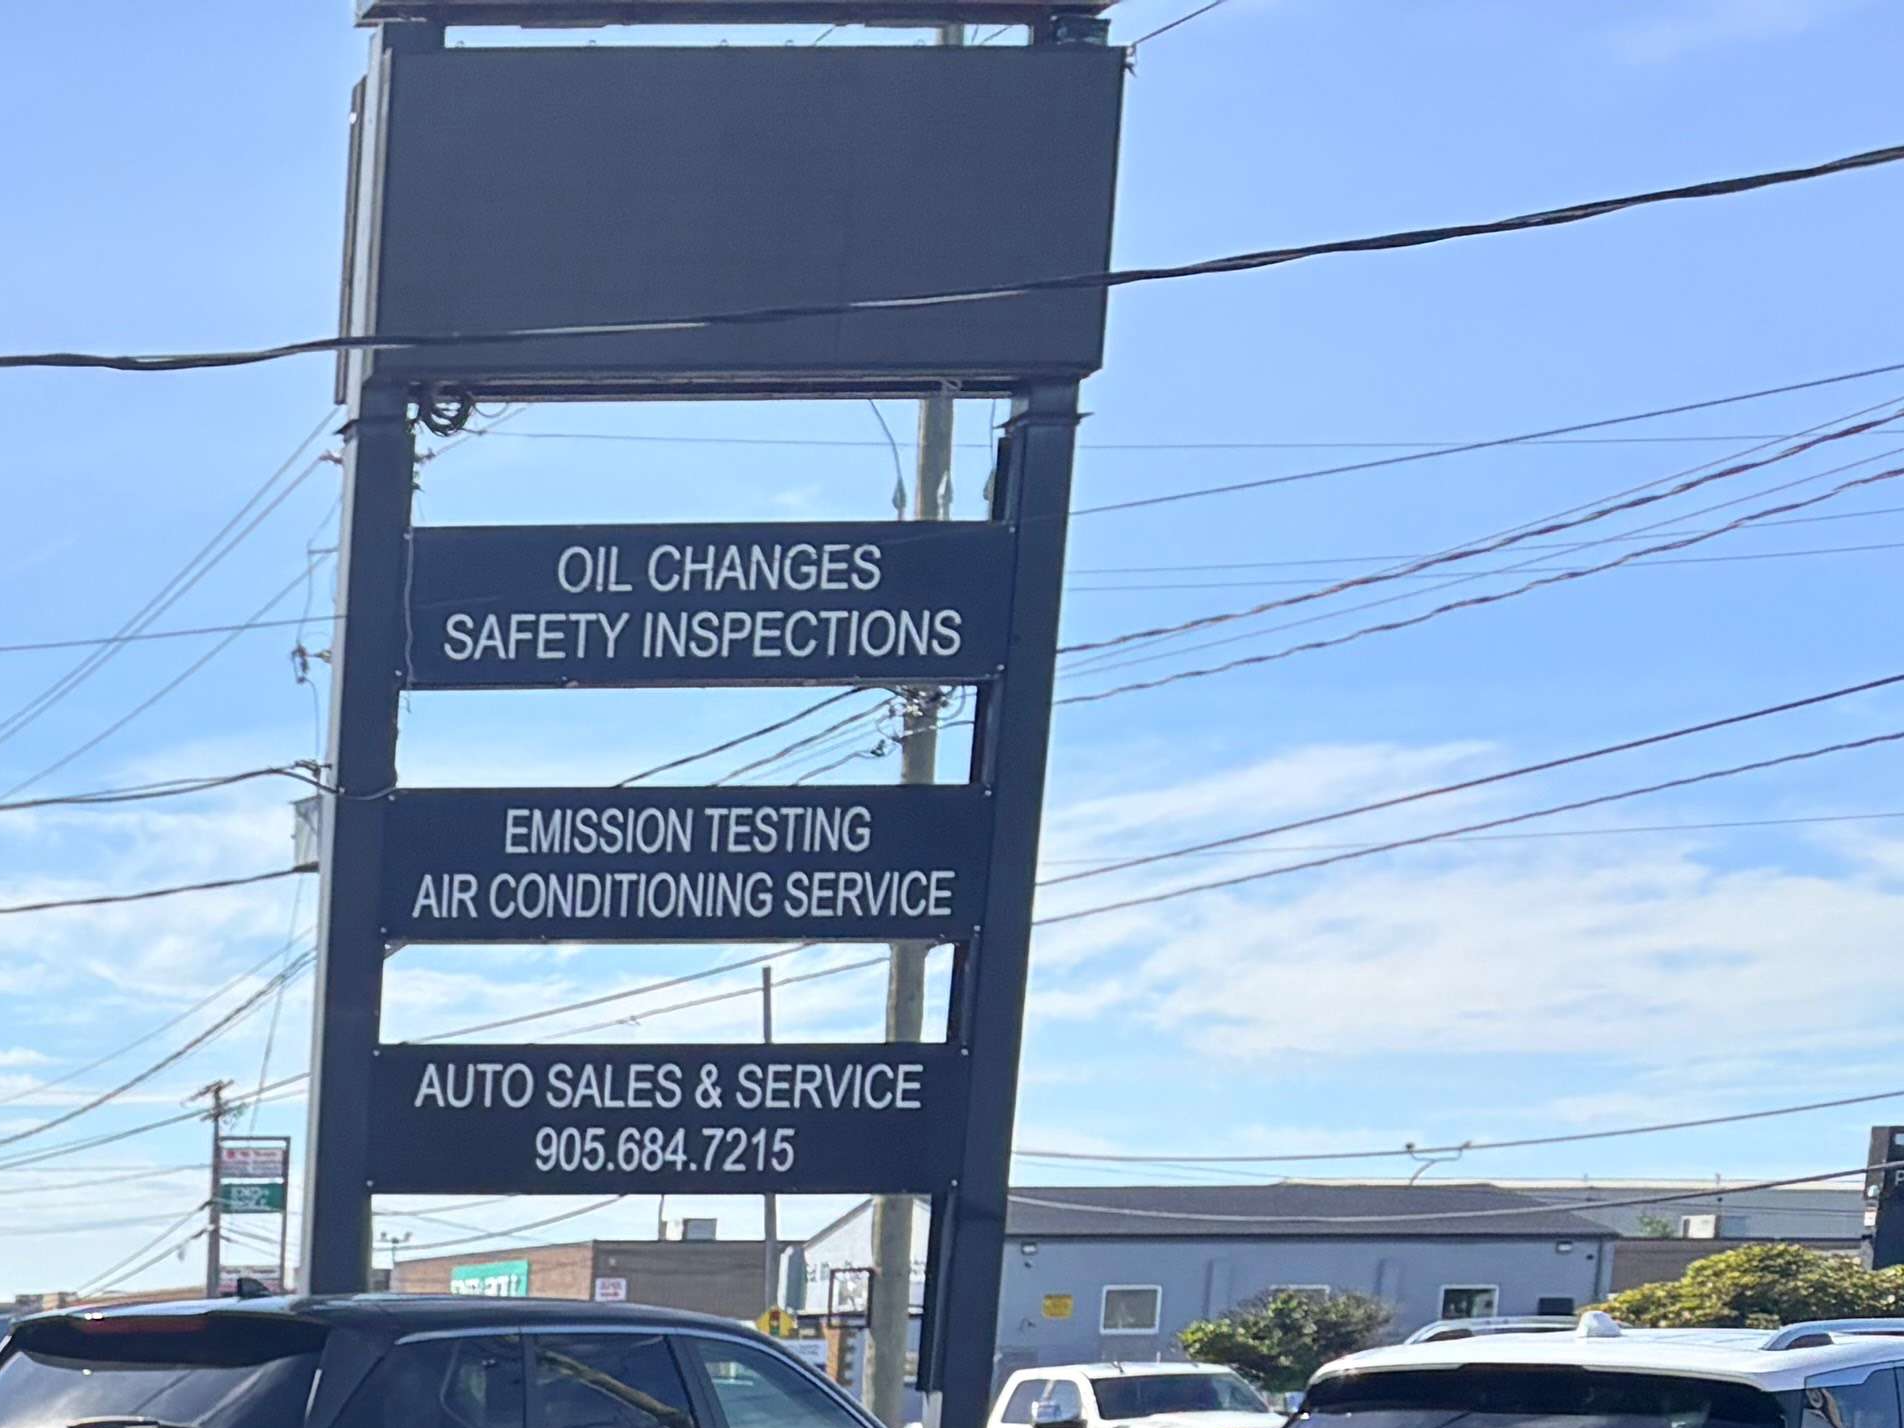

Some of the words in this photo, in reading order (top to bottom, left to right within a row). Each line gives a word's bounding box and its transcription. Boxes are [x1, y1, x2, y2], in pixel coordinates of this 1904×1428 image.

[558, 545, 634, 593] OIL
[648, 543, 882, 592] CHANGES
[444, 612, 630, 660] SAFETY
[642, 609, 962, 658] INSPECTIONS
[505, 807, 694, 853] EMISSION
[704, 806, 871, 852] TESTING
[412, 873, 478, 918] AIR
[489, 872, 774, 919] CONDITIONING
[784, 870, 956, 917] SERVICE
[414, 1063, 534, 1108] AUTO
[546, 1063, 683, 1108] SALES
[695, 1063, 722, 1109] &
[736, 1063, 924, 1109] SERVICE
[536, 1127, 796, 1172] 905.684.7215
